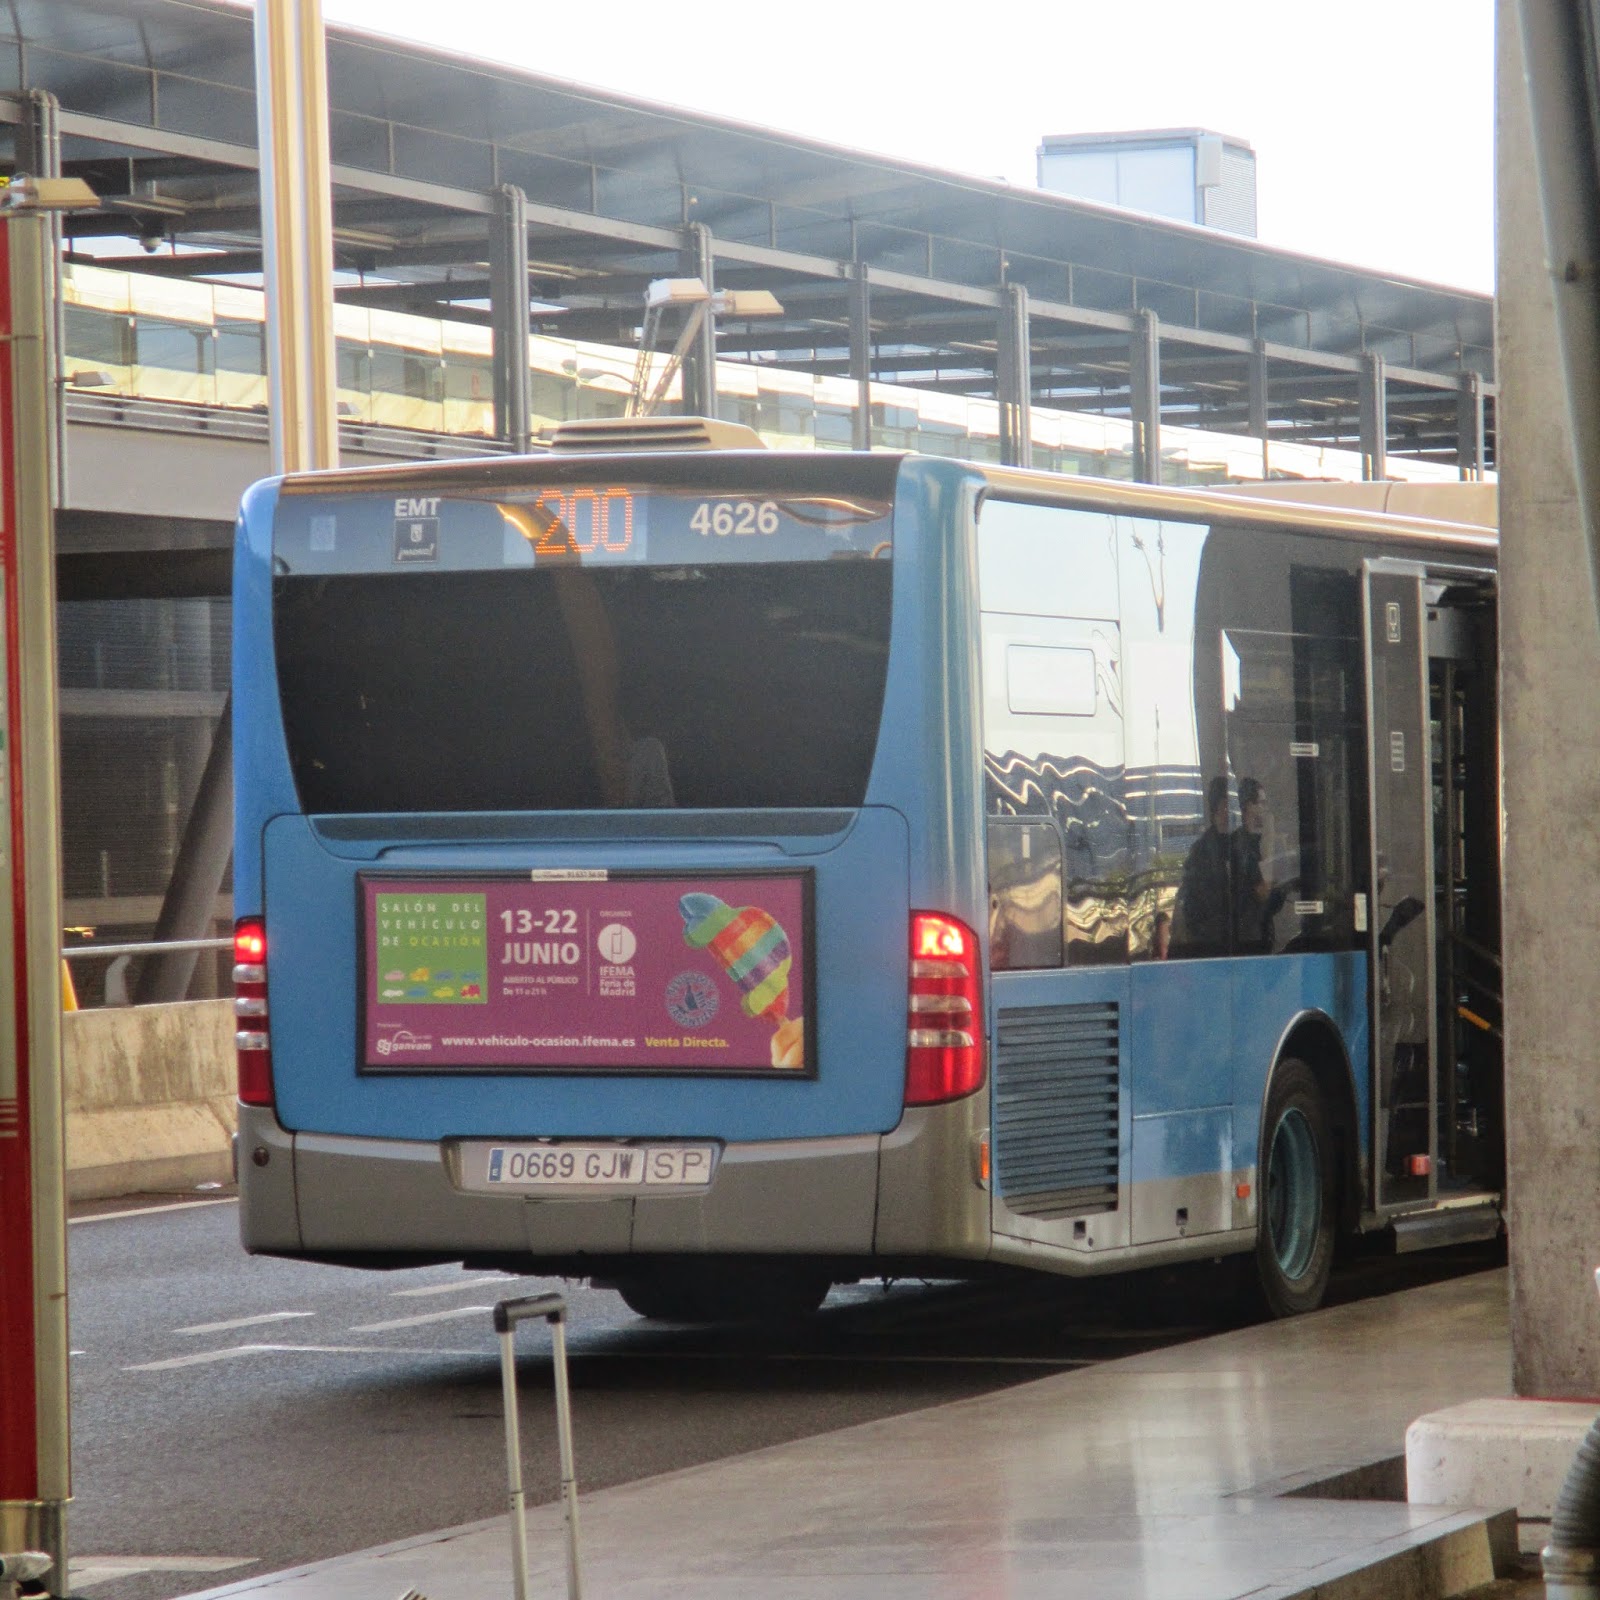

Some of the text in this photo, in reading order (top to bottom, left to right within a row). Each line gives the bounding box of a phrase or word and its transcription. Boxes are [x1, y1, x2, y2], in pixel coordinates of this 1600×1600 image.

[394, 497, 441, 517] EMT
[535, 487, 633, 555] 200
[689, 501, 780, 537] 4626
[451, 902, 480, 913] DEL
[381, 917, 481, 930] VEHÍCULO
[499, 909, 578, 934] 13-22
[382, 936, 399, 946] DE
[501, 942, 580, 965] JUNIO
[599, 966, 635, 976] IFEMA
[599, 979, 635, 988] Feria de
[599, 987, 636, 996] Madrid
[441, 1035, 636, 1048] www.vehiculo-ocasion.ifema.es
[644, 1036, 730, 1048] Venta Directa.
[510, 1152, 634, 1179] 0669 GJW
